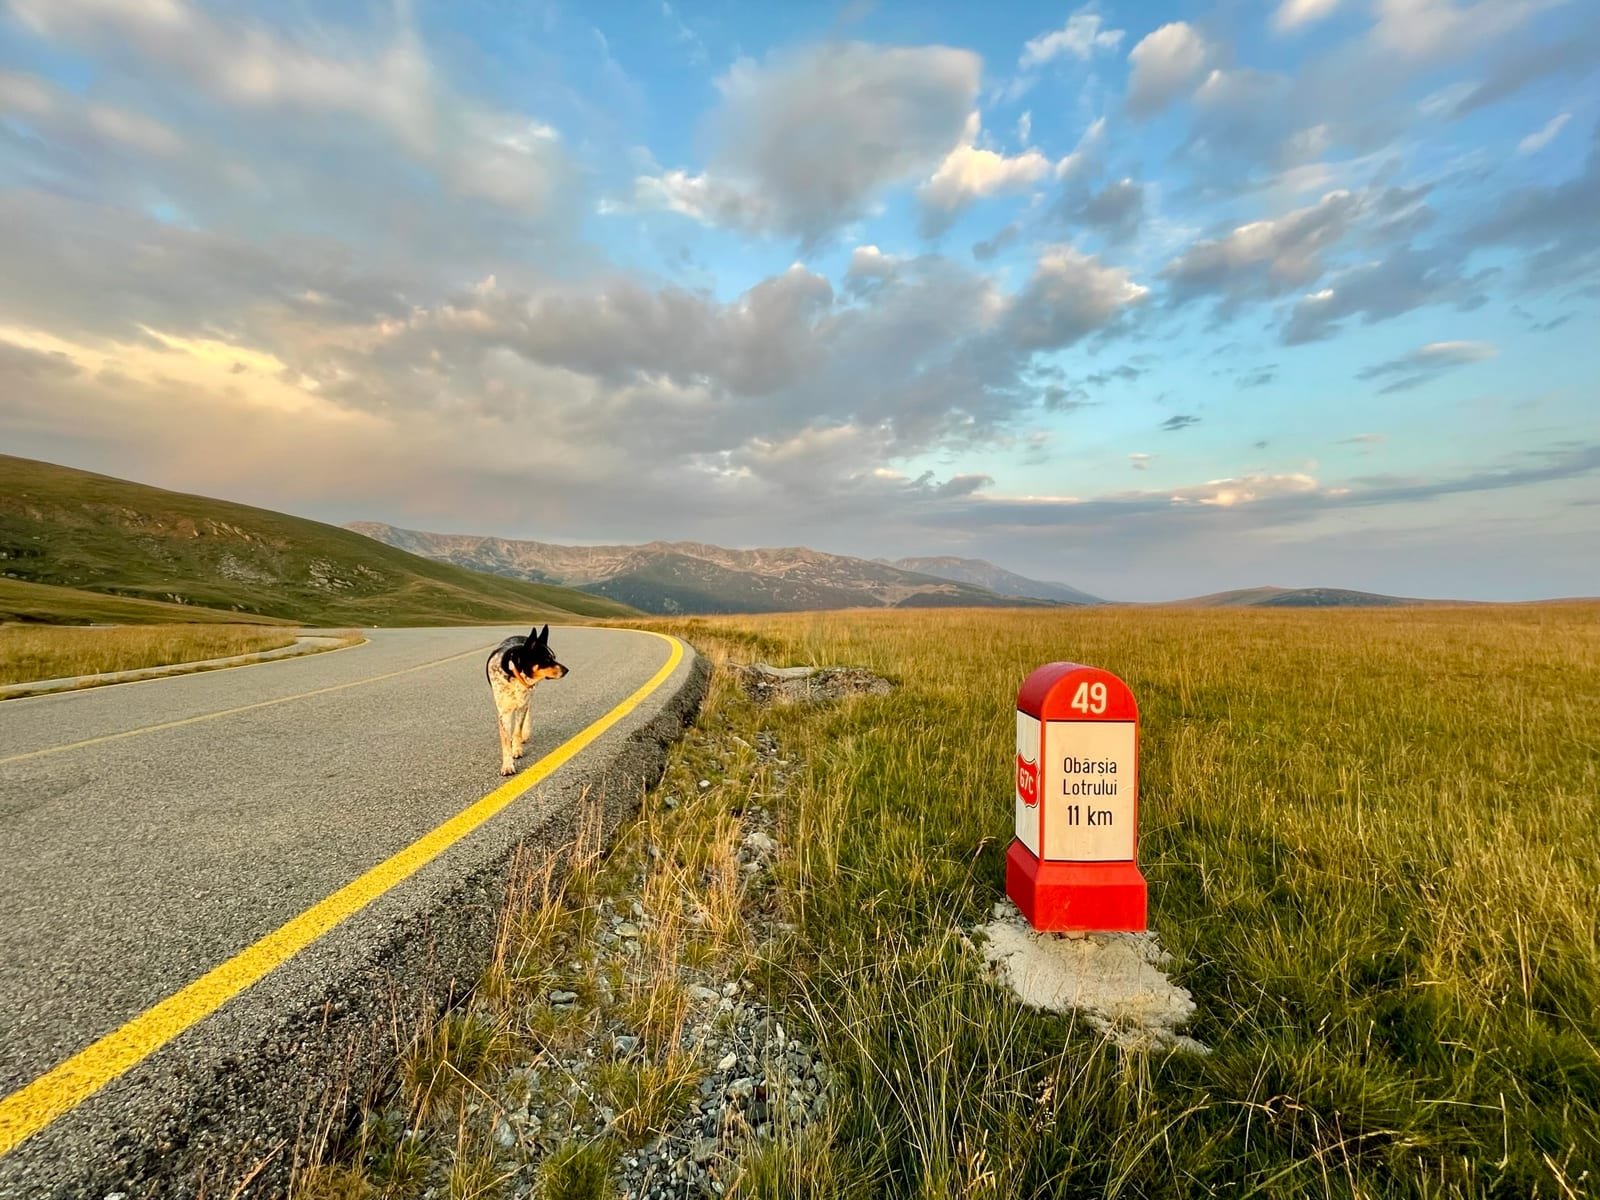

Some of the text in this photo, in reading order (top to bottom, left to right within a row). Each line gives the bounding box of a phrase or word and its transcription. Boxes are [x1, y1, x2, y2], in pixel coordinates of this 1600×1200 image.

[1071, 682, 1107, 714] 49
[1063, 778, 1117, 796] Lotrului
[1067, 805, 1113, 826] 11 km
